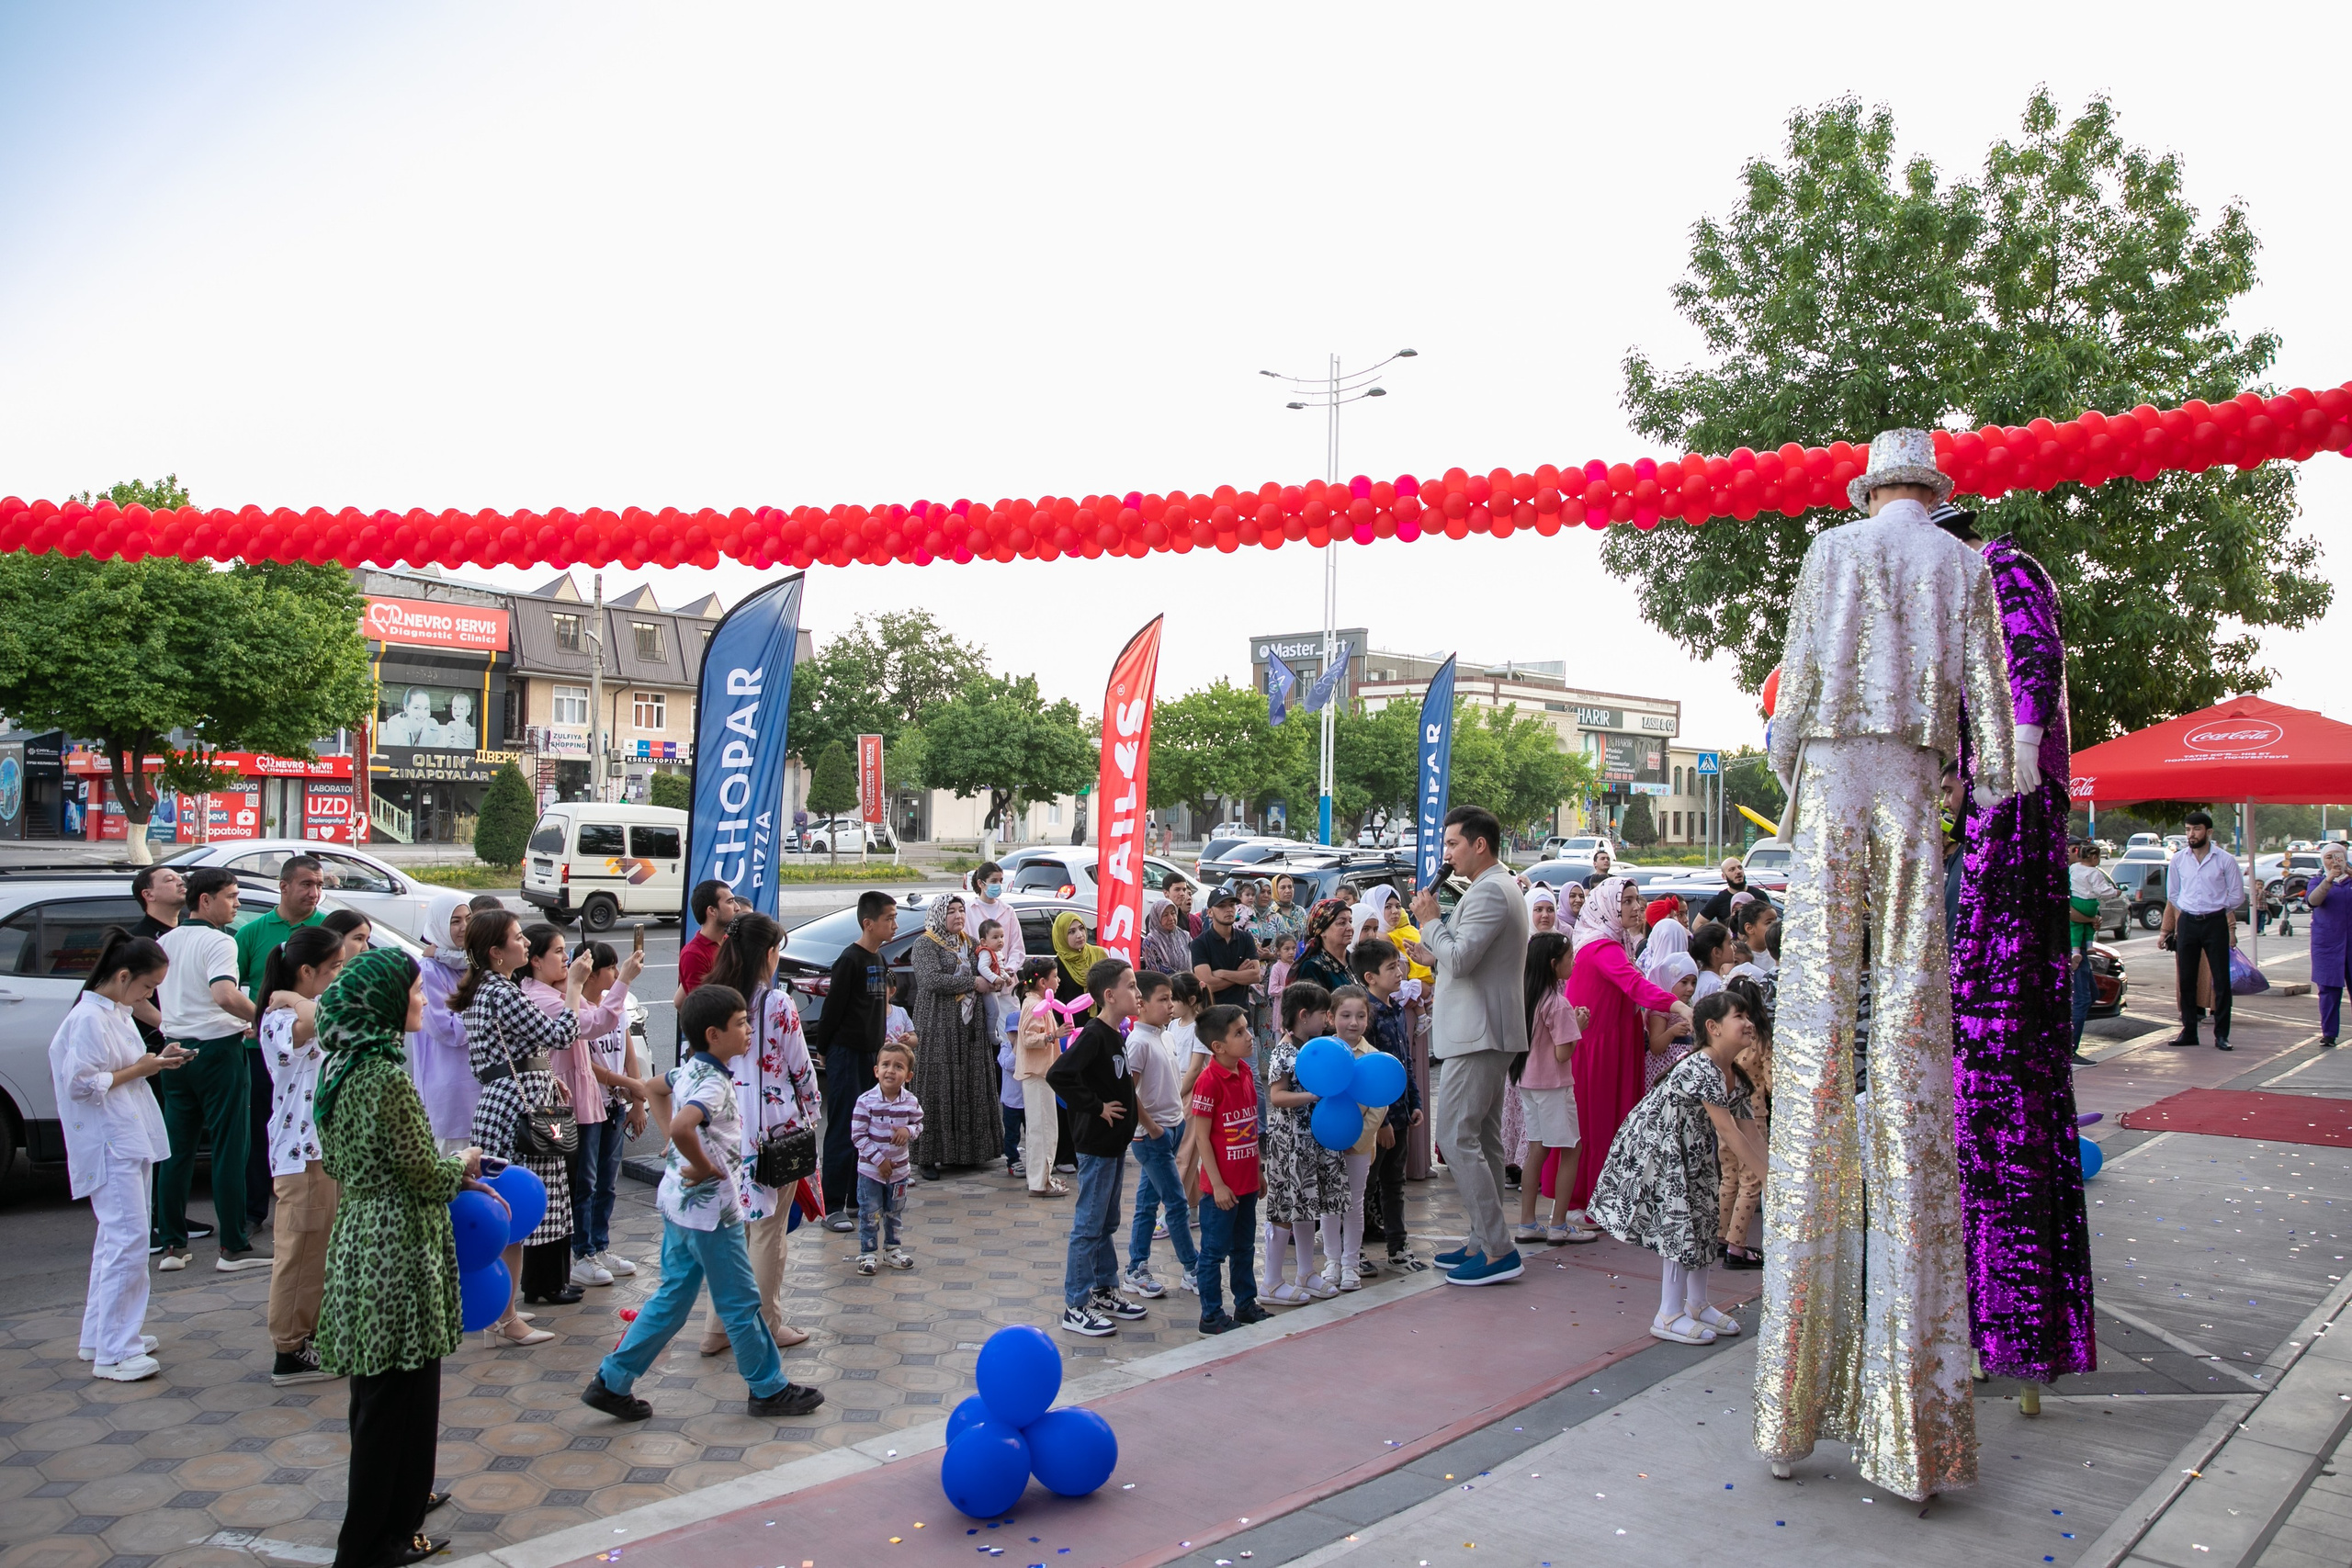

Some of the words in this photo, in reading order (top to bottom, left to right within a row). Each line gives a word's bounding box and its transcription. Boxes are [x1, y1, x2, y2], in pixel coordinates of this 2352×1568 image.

[403, 613, 452, 631] NEVRO
[455, 617, 496, 635] SERVIS
[390, 626, 452, 639] Diagnostic
[459, 632, 496, 643] Clinics
[1577, 707, 1610, 727] HARIR
[2190, 729, 2275, 742] Coca-Cola
[1615, 738, 1634, 749] HARIR
[412, 754, 467, 769] OLTIN
[475, 750, 520, 764] ДВЕРИ
[627, 756, 683, 764] KSEROKOPIYA
[276, 761, 304, 769] NEVRO
[390, 768, 490, 781] ZINAPOYALAR
[714, 666, 763, 889] CHOPAR
[308, 797, 348, 815] UZD
[752, 810, 772, 888] PIZZA
